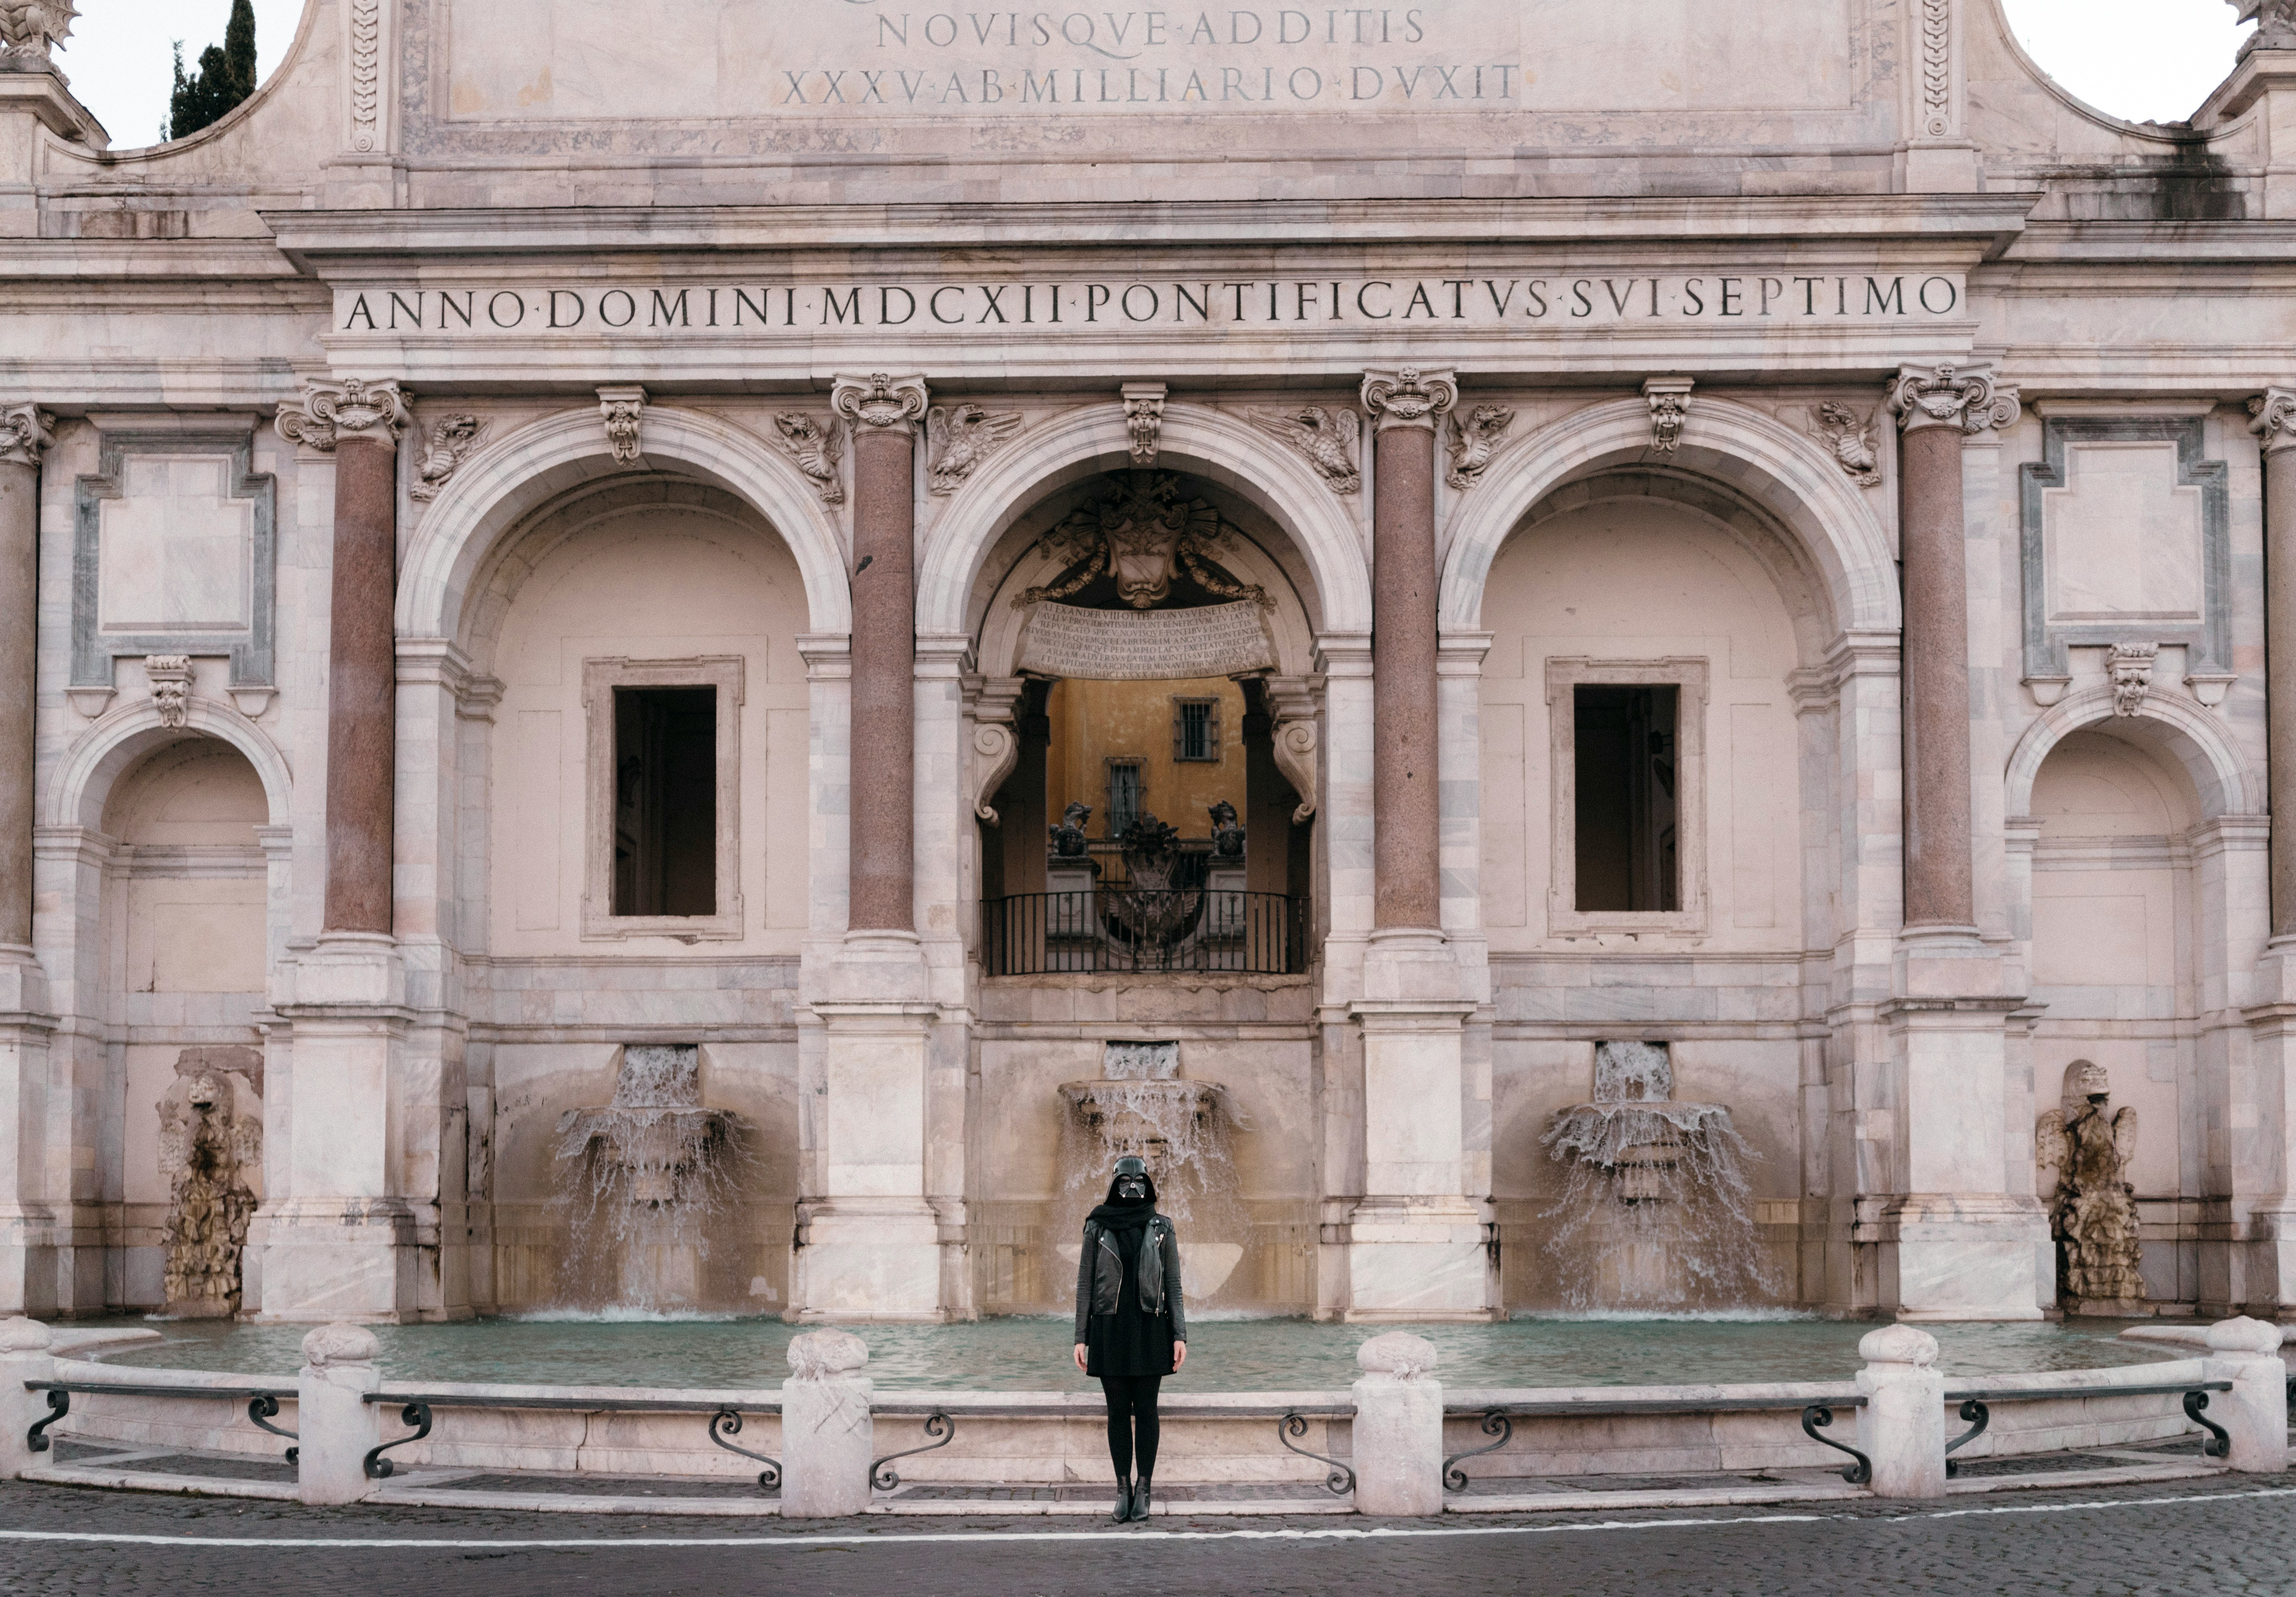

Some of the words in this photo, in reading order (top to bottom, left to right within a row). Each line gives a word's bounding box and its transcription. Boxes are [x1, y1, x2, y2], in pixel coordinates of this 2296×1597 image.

[876, 10, 1168, 59] NOVISQVE
[1188, 9, 1425, 47] ADDITIS
[781, 70, 927, 105] XXXV
[936, 69, 1004, 104] AB
[1018, 65, 1324, 104] MILLIARIO
[1346, 63, 1521, 102] DVXIT
[342, 290, 526, 330] ANNO
[546, 288, 797, 329] DOMINI
[819, 284, 1061, 325] MDCXII
[1084, 279, 1548, 324] PONTIFICATVS
[1571, 278, 1662, 319] SVI
[1682, 275, 1957, 317] SEPTIMO
[1041, 603, 1100, 618] ALEXANDER
[1122, 611, 1190, 620] OTTHOBONVS
